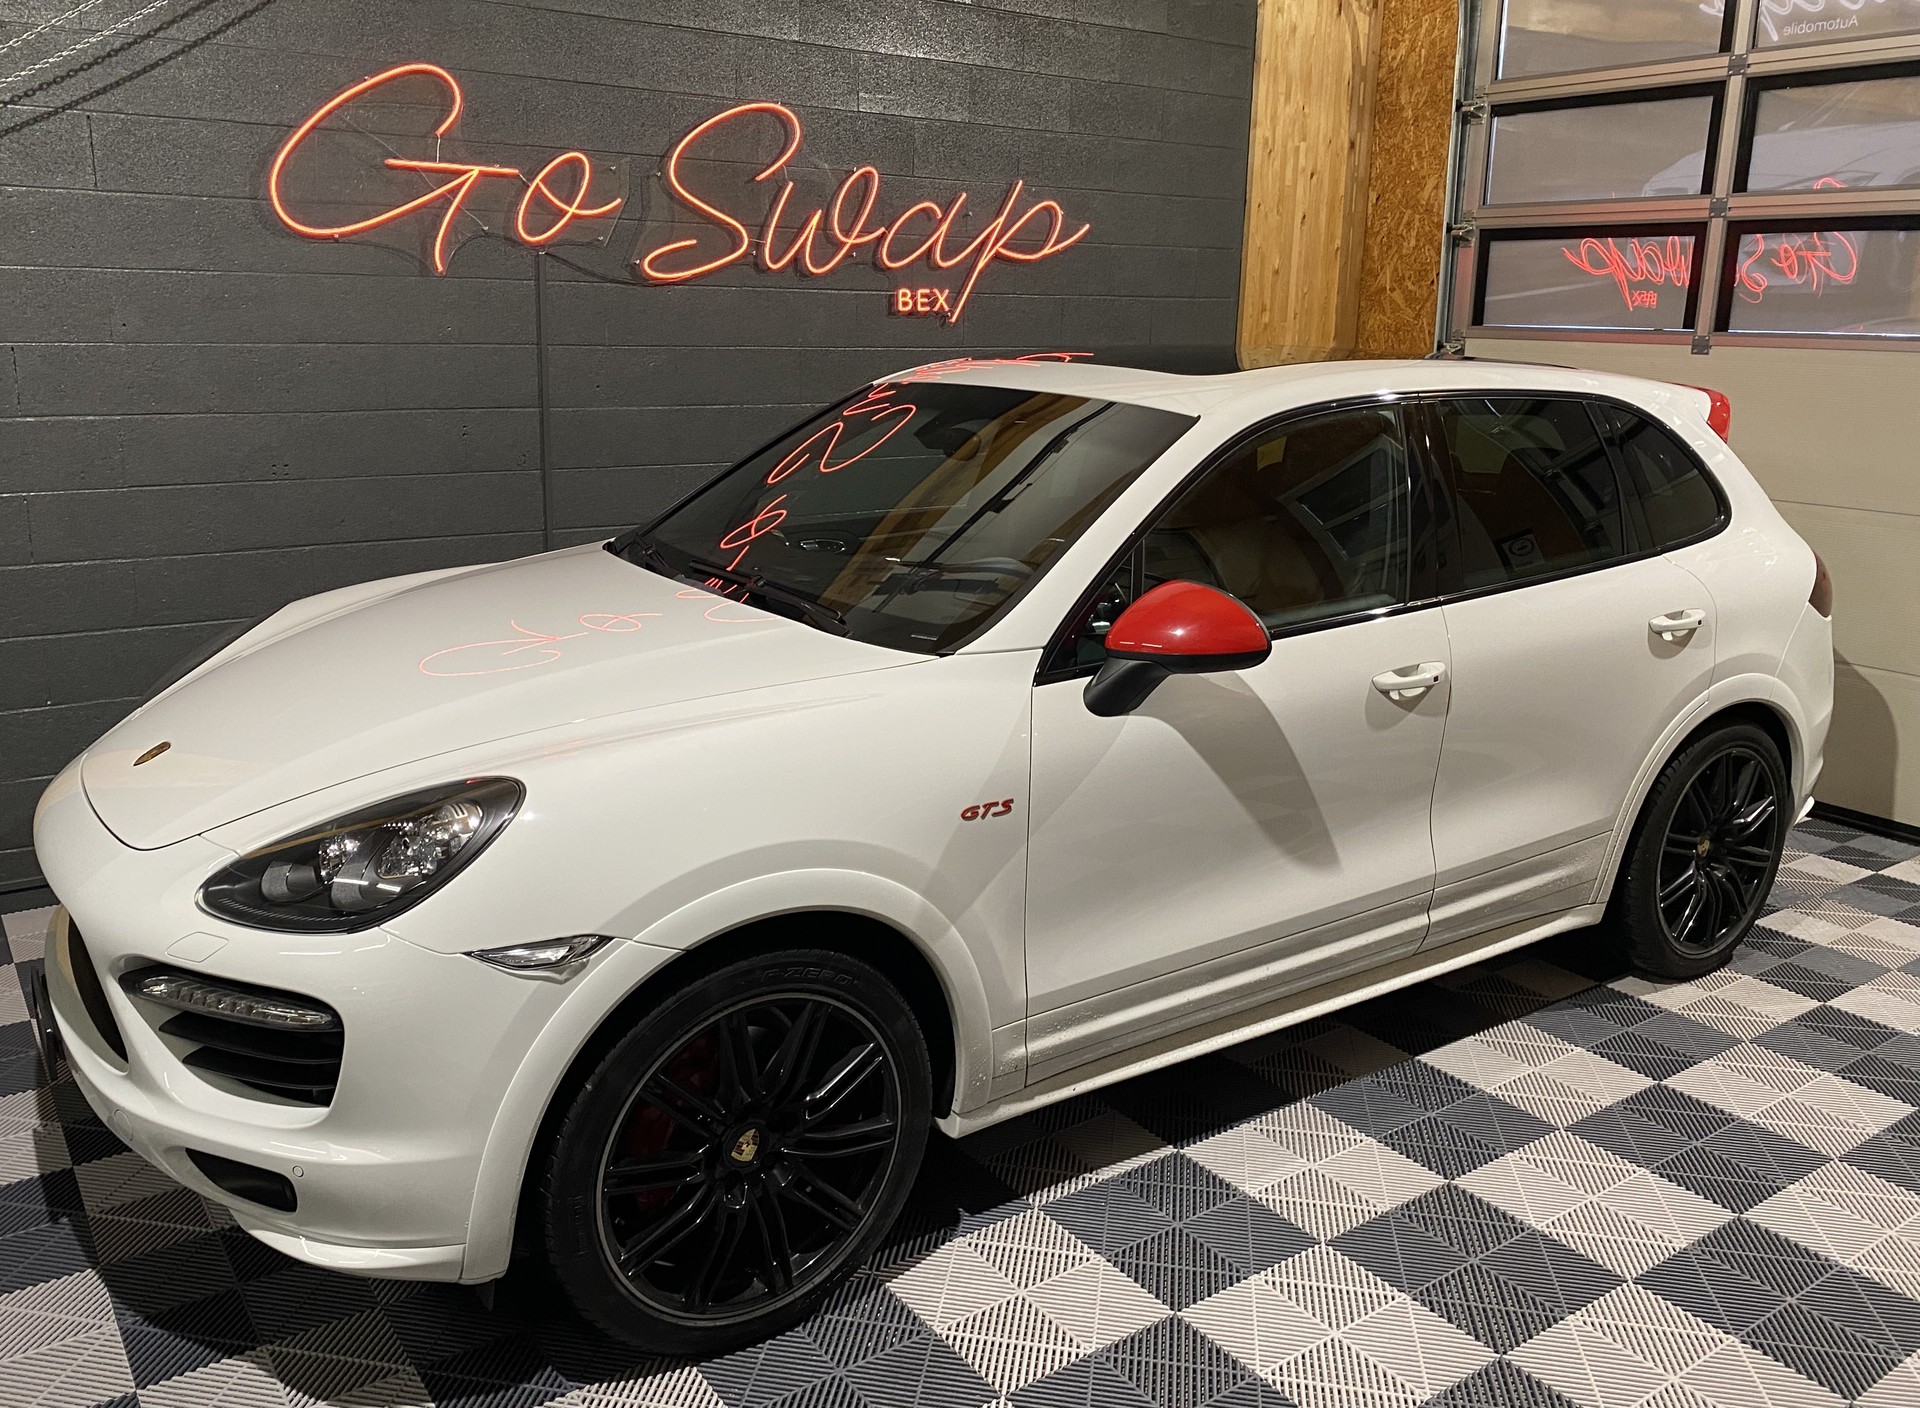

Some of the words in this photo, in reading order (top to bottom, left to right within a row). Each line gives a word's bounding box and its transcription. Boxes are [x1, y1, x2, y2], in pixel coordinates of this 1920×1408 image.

[269, 62, 622, 274] Go
[640, 101, 1091, 325] Swap
[896, 287, 951, 314] BEX
[960, 798, 1014, 821] GTS
